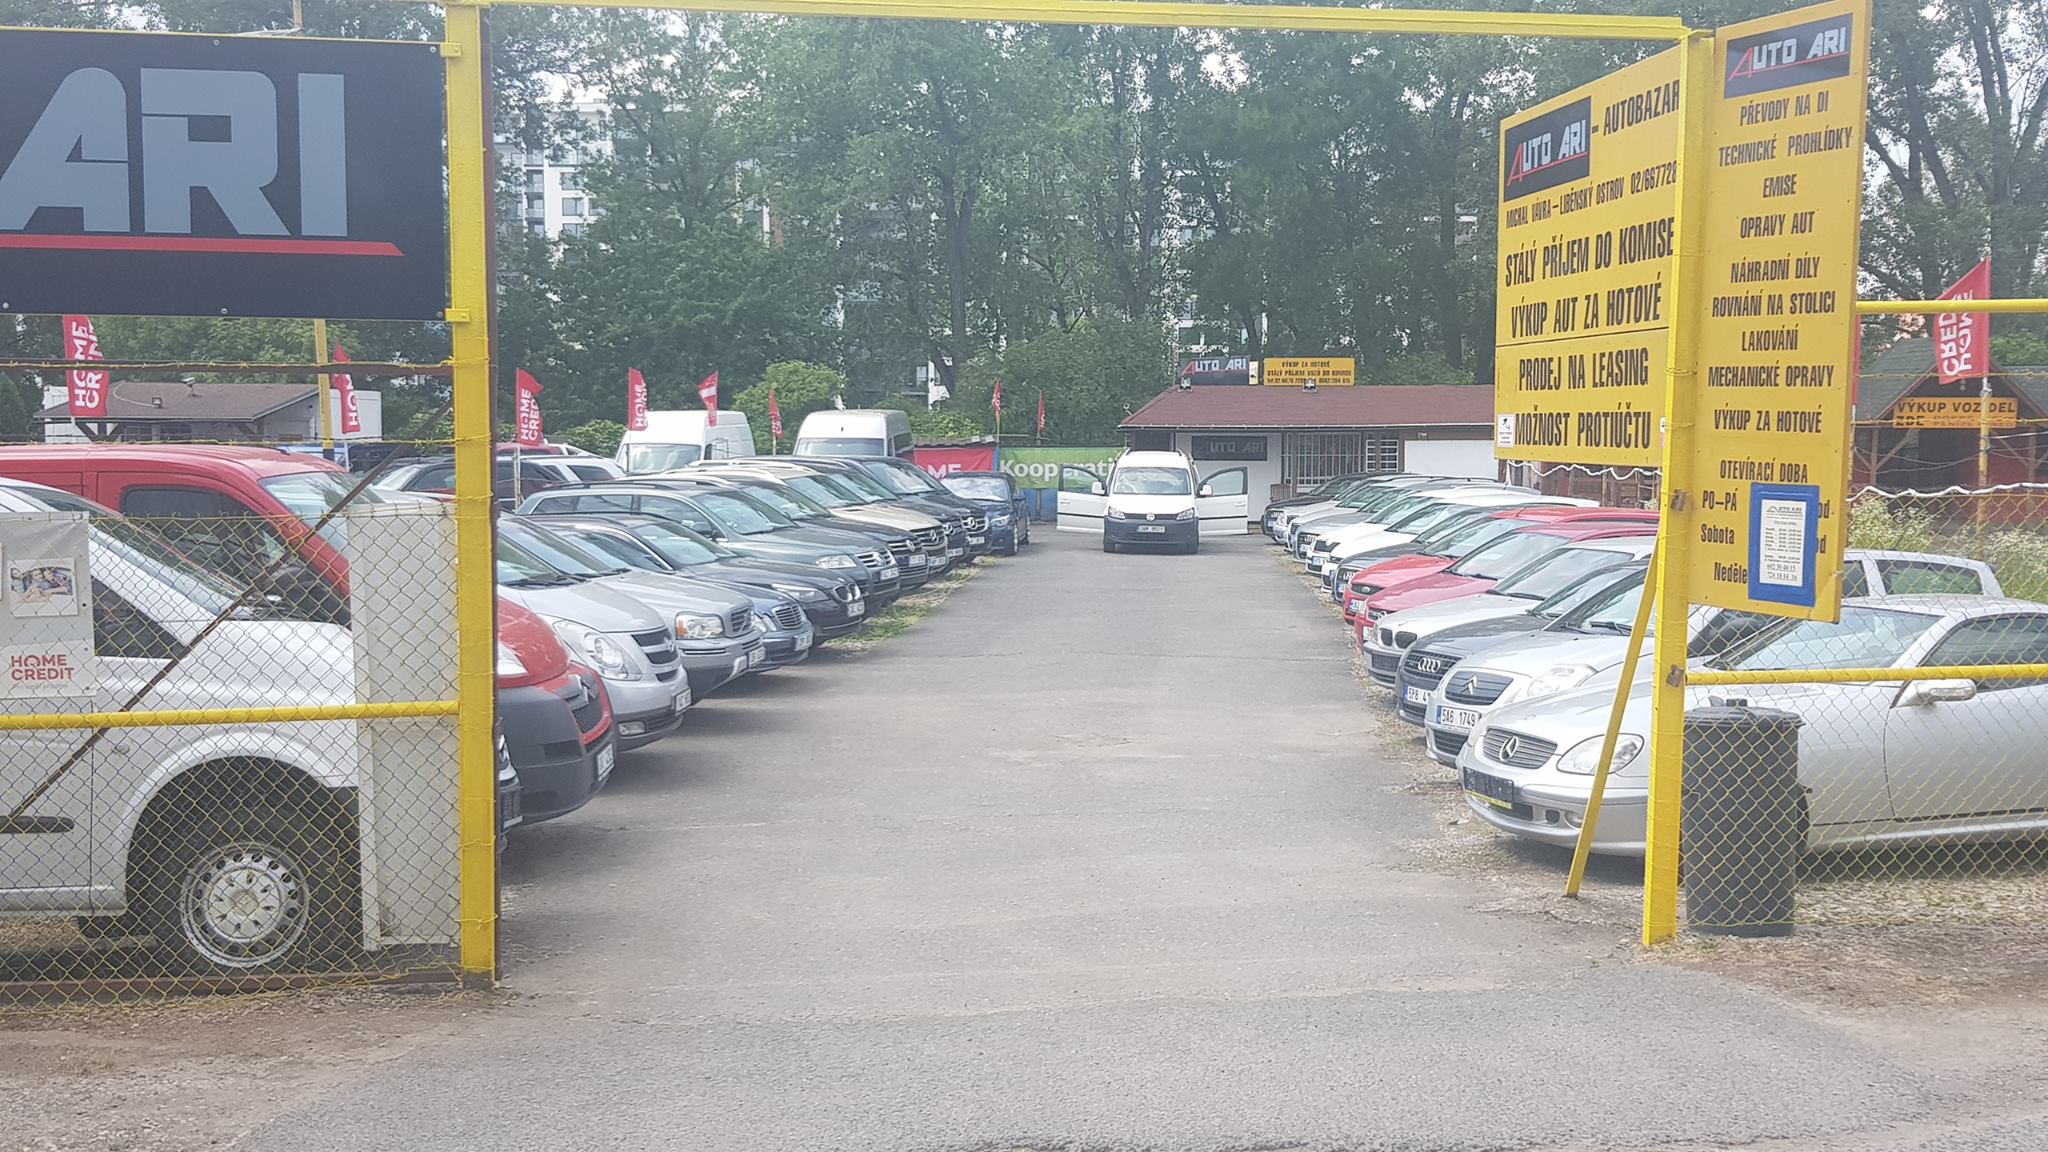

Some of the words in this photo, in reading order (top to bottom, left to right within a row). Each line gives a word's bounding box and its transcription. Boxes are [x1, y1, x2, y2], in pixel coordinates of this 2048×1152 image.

[1728, 38, 1797, 81] AUTO
[1806, 26, 1847, 59] ARI
[1739, 97, 1790, 126] PŘEVODY
[1794, 95, 1811, 116] NA
[1817, 91, 1829, 113] DI
[1507, 132, 1552, 187] AUTO
[1558, 119, 1587, 159] ARI
[1603, 79, 1680, 136] AUTOBAZAR
[1719, 133, 1777, 167] TECHNICKÉ
[1787, 125, 1853, 157] PROHLÍDKY
[0, 66, 348, 237] ARI
[1762, 174, 1798, 199] EMISE
[1506, 205, 1528, 229] MICHAL
[1596, 176, 1625, 205] OSTROV
[1740, 213, 1786, 239] OPRAVY
[1791, 211, 1816, 235] AUT
[1505, 239, 1537, 287] STÁLÝ
[1542, 233, 1590, 280] PŘÍJEM
[1595, 231, 1612, 270] DO
[1619, 216, 1674, 265] KOMISE
[1730, 252, 1790, 284] NÁHRADNÍ
[1795, 251, 1820, 279] DÍLY
[1511, 296, 1547, 338] VÝKUP
[1553, 297, 1578, 334] AUT
[1584, 293, 1599, 329] ZA
[1607, 271, 1661, 327] HOTOVÉ
[1712, 289, 1763, 318] ROVNÁNÍ
[1767, 293, 1784, 315] NA
[1789, 290, 1836, 315] STOLICI
[1741, 323, 1799, 351] LAKOVÁNÍ
[1181, 359, 1220, 376] AUTO
[1225, 358, 1247, 370] ARI
[1519, 354, 1562, 391] PRODEJ
[1568, 354, 1586, 389] NA
[1592, 347, 1649, 388] LEASING
[1708, 359, 1780, 387] MECHANICKÉ
[1785, 365, 1835, 387] OPRAVY
[520, 388, 531, 440] HOME
[1714, 402, 1751, 430] VÝKUP
[1755, 410, 1771, 432] ZA
[1776, 404, 1822, 434] HOTOVÉ
[1897, 398, 1946, 413] VÝKUP
[1953, 402, 2015, 413] VOZDEL
[1515, 403, 1570, 446] MOŽNOST
[1577, 401, 1651, 449] PROTIÚČTU
[1242, 441, 1264, 453] ARI
[1720, 456, 1776, 482] OTEVÍRACÍ
[1779, 463, 1808, 483] DOBA
[1701, 523, 1735, 545] Sobota
[1714, 562, 1748, 584] Neděle
[10, 654, 67, 668] HOME
[11, 668, 75, 681] CREDIT
[1442, 709, 1455, 723] 5A6
[1459, 711, 1475, 727] 1749
